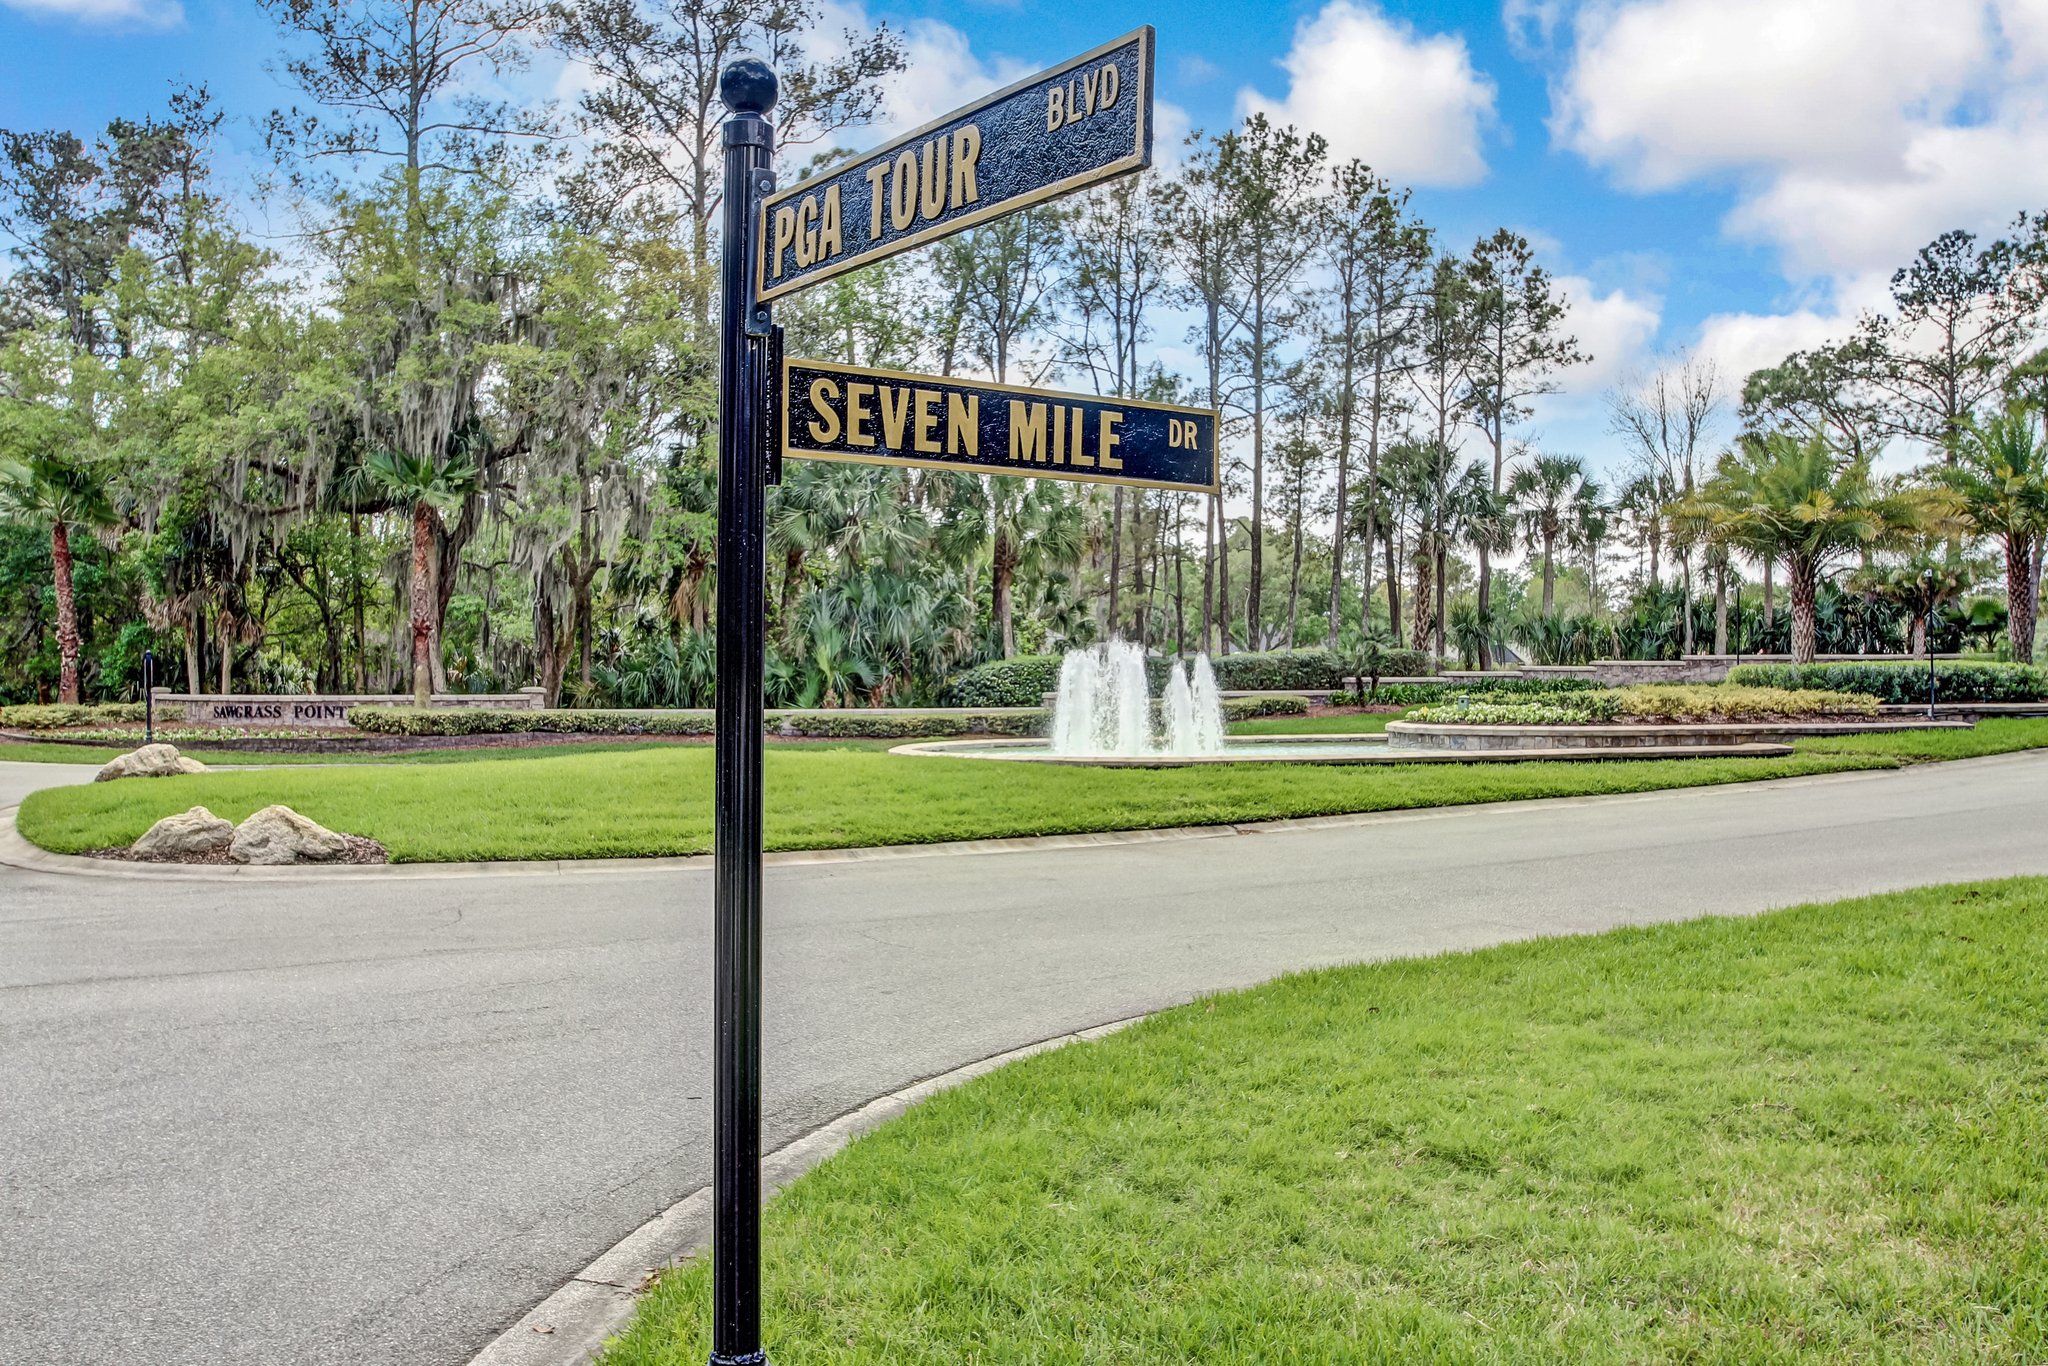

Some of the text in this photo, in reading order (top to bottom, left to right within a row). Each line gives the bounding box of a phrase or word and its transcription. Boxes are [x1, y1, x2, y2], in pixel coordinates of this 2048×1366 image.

[773, 64, 1120, 277] PGA TOUR BLVD
[808, 378, 1198, 469] SEVEN MILE DR
[213, 705, 356, 719] SAWGRASS POINT
